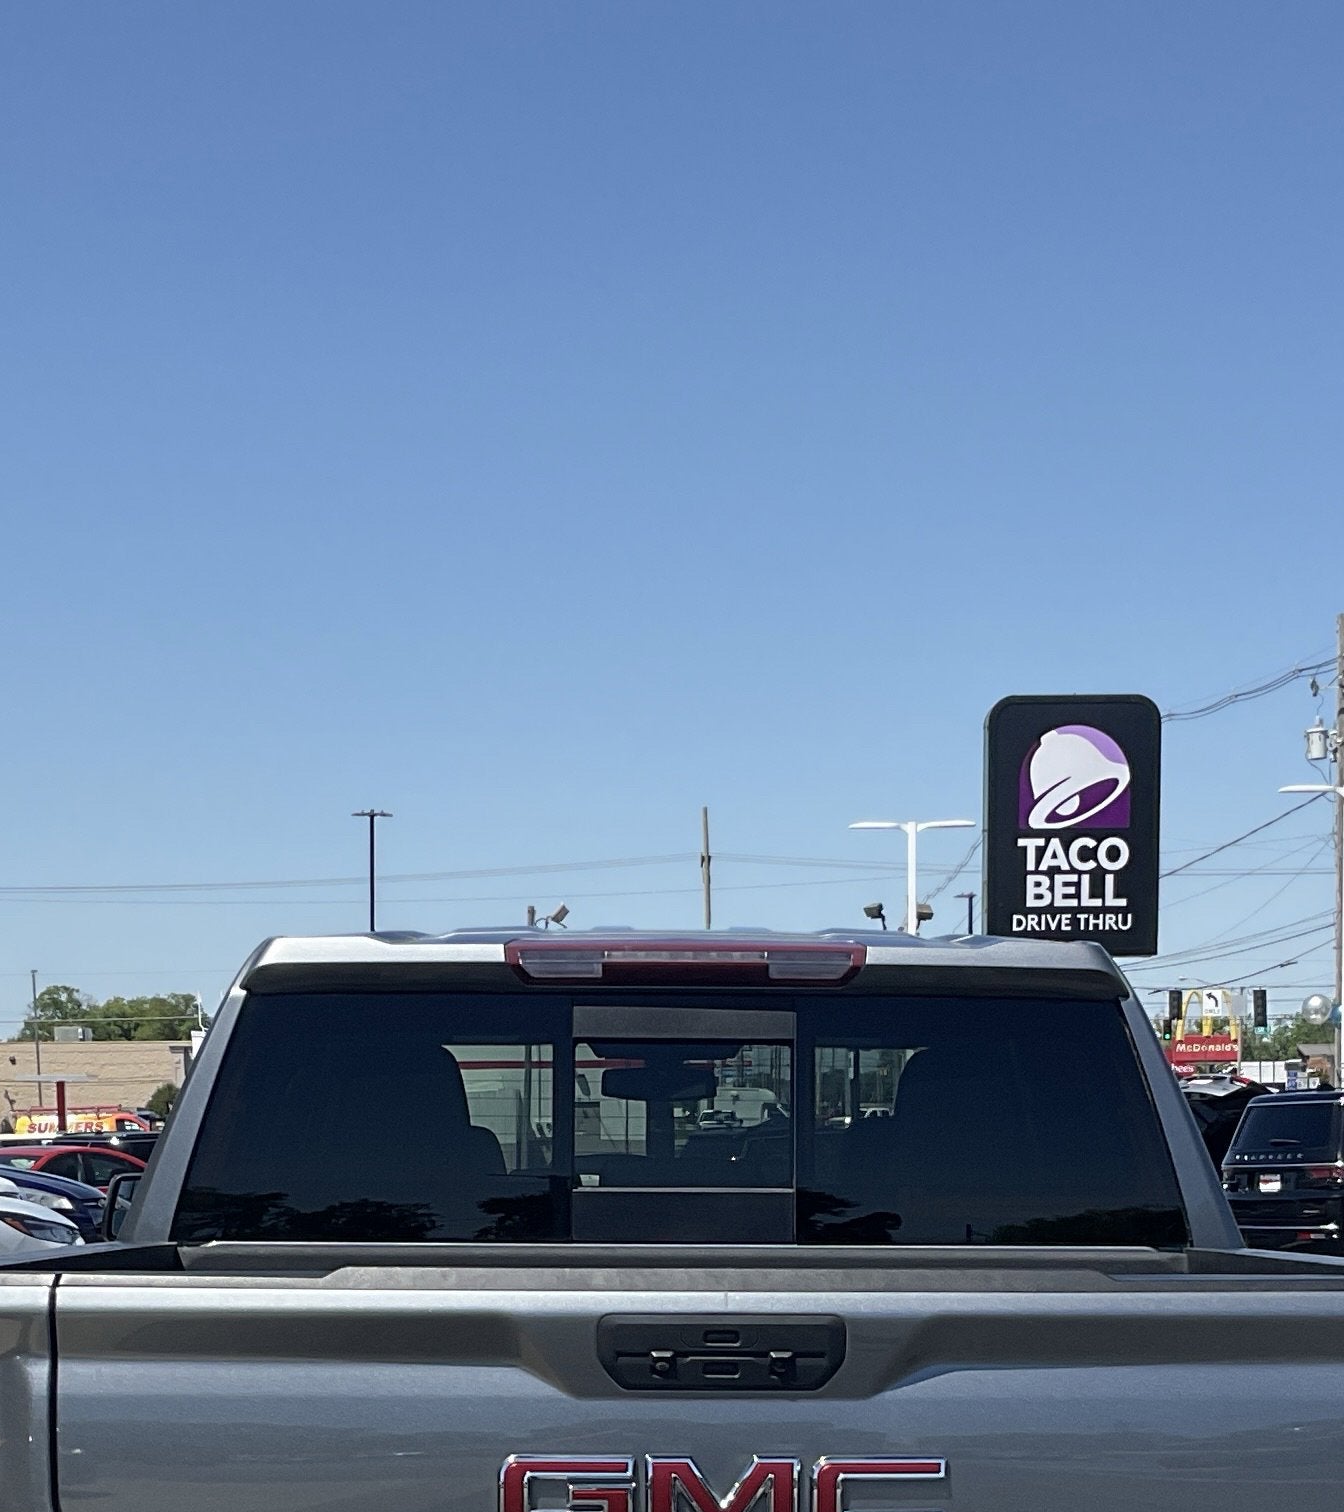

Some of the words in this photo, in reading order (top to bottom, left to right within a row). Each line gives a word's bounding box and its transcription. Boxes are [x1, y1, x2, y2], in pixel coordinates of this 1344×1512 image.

[1017, 837, 1130, 871] TACO
[1026, 874, 1128, 907] BELL
[1012, 914, 1072, 932] DRIVE
[1077, 913, 1132, 931] THRU
[1176, 1043, 1239, 1053] McDonald's
